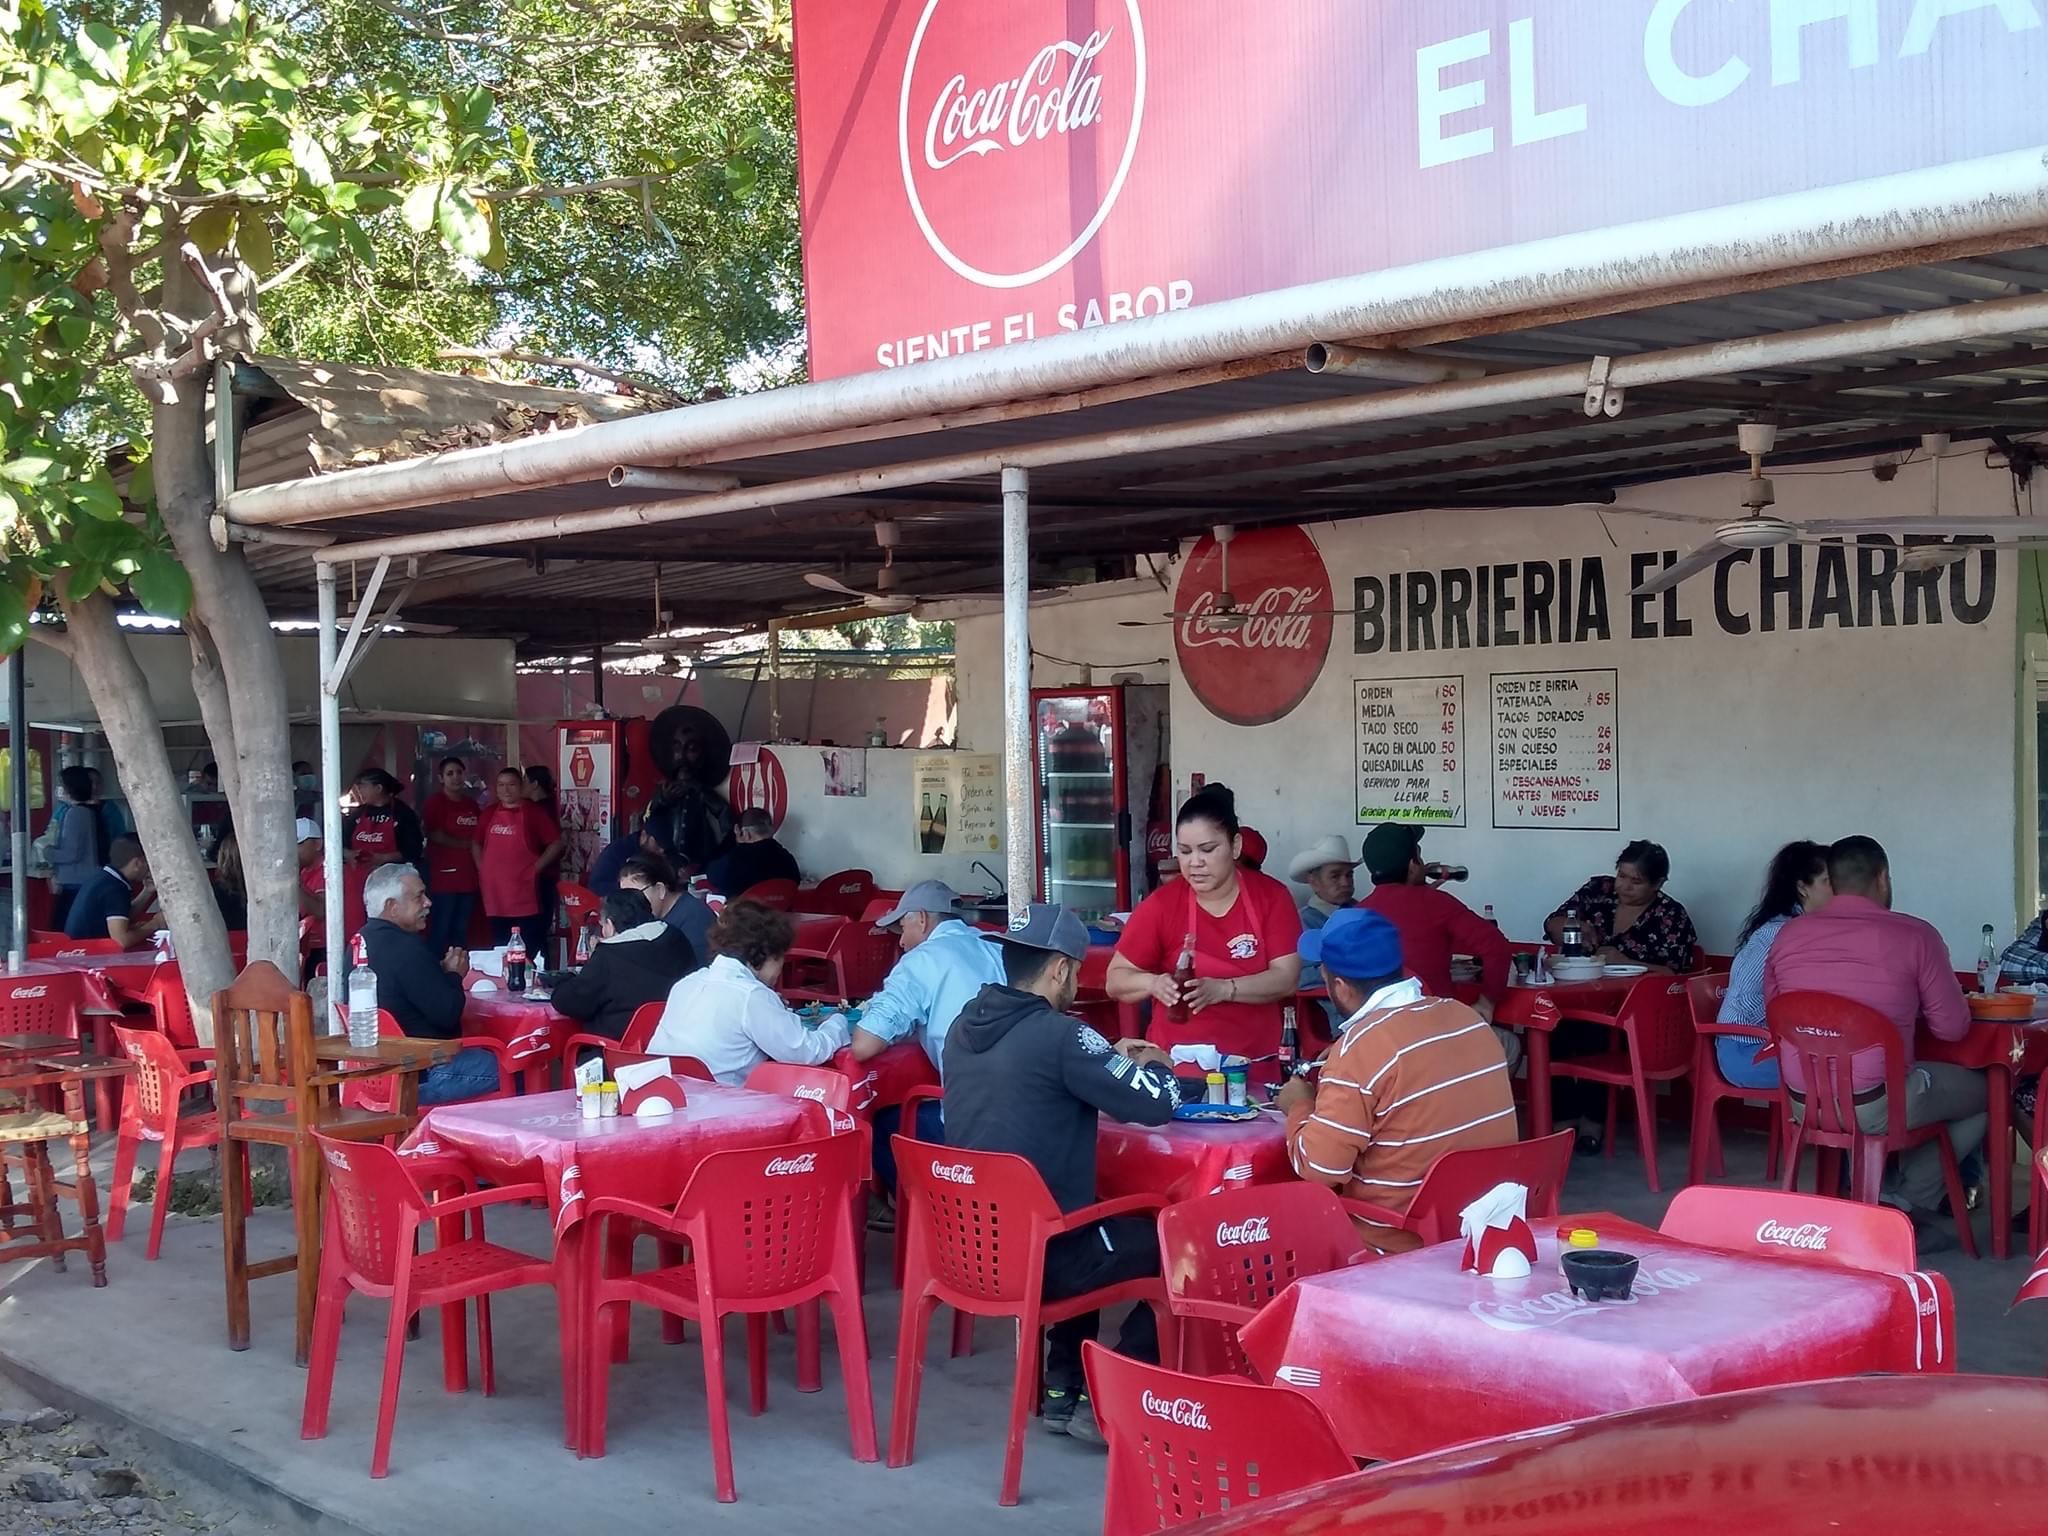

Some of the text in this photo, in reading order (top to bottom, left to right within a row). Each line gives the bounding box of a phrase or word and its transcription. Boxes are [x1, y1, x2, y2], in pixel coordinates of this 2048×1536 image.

[925, 26, 1114, 169] Coca-Cola
[1416, 17, 1588, 169] EL
[877, 321, 991, 368] SIENTE
[1057, 280, 1194, 331] SABOR
[1354, 533, 1998, 654] BIRRIERIA EL CHARRO
[1361, 685, 1457, 700] ORDEN 80
[1496, 680, 1578, 693] ORDEN DE BIRRIA
[1496, 695, 1552, 708] TATEMADA
[1362, 703, 1456, 718] MEDIA 70
[1497, 710, 1585, 723] TACOS DORADOS
[1361, 721, 1454, 735] TACO SECO 45
[1497, 726, 1612, 740] CON QUESO 26
[1363, 741, 1456, 755] TACO EN CALDO 50
[1498, 742, 1611, 755] SIN QUESO 24
[1361, 759, 1456, 773] QUESADILLAS 50
[1498, 759, 1558, 771] ESPECIALES
[1363, 778, 1430, 789] SERVICIO PARA
[1512, 776, 1582, 787] DESCANSAMOS
[1393, 790, 1449, 803] LLEVAR 5
[1502, 790, 1600, 801] MARTES MIERCOLES
[1517, 805, 1566, 817] Y JUEVES
[932, 1160, 976, 1185] Coca-Cola
[1217, 1217, 1270, 1247] Coca-Cola
[1756, 1220, 1833, 1250] Coca-Cola
[1142, 1390, 1212, 1431] Coca-Cola
